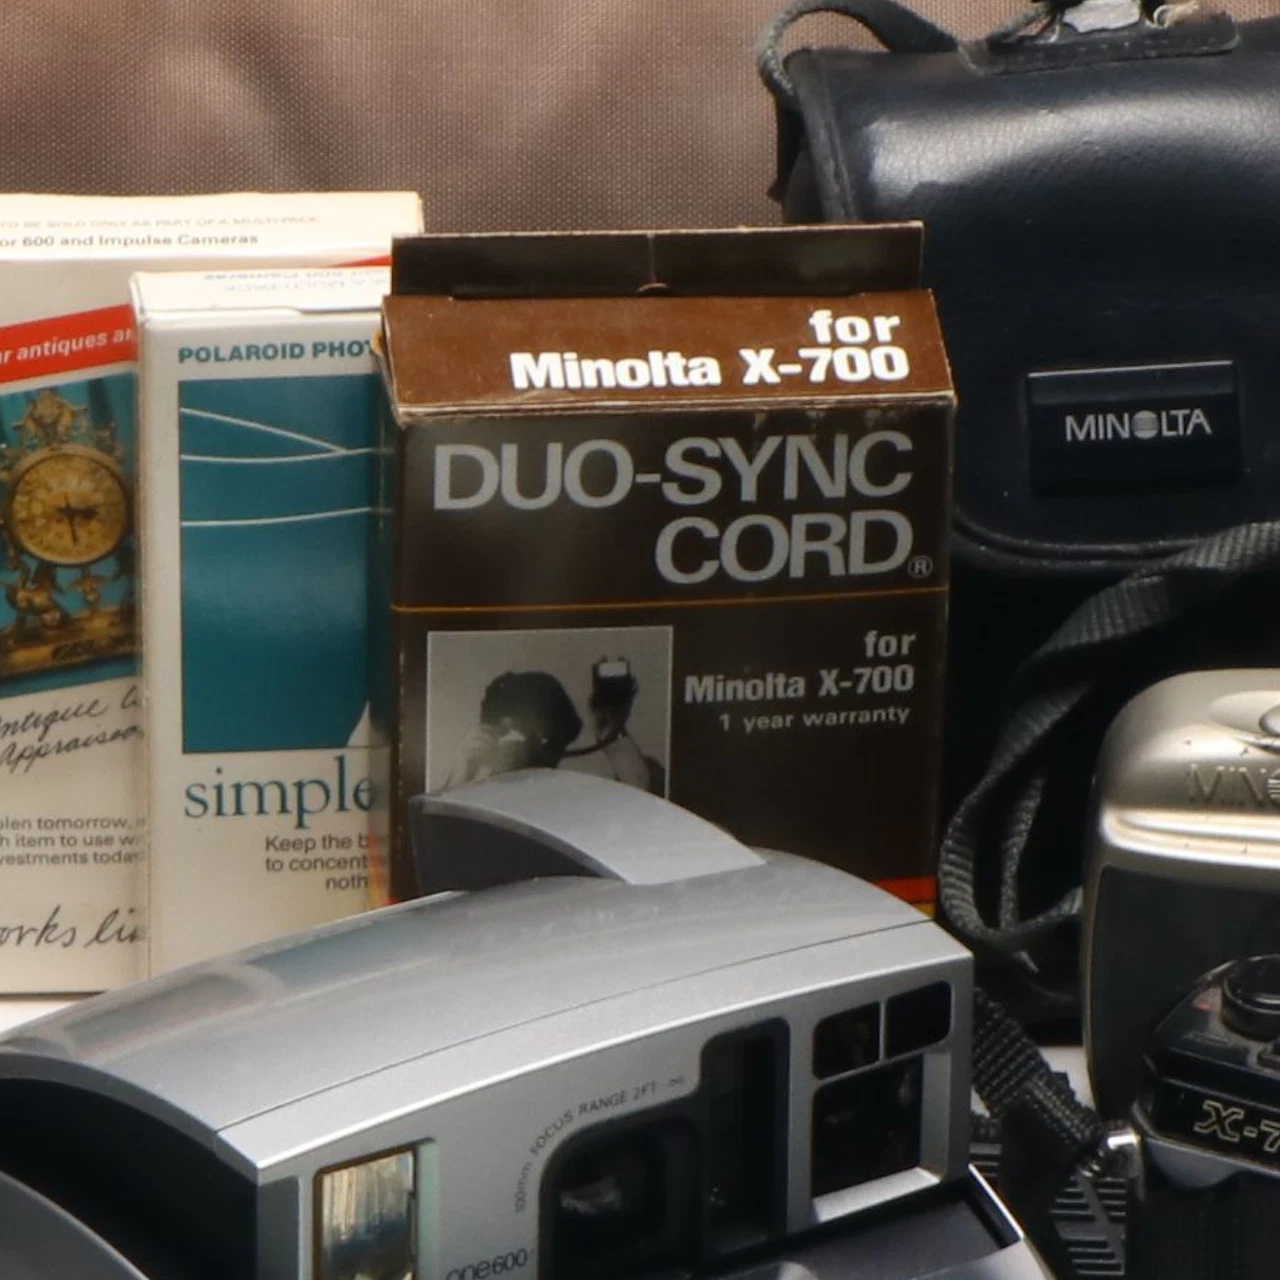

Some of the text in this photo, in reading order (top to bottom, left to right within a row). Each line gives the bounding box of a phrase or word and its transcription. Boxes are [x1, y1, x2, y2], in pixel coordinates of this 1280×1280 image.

[21, 236, 55, 248] 600
[59, 235, 95, 247] and
[98, 234, 173, 249] Impulse
[177, 233, 259, 247] Cameras
[809, 309, 901, 346] for
[16, 329, 108, 361] antiques
[113, 327, 133, 344] ar
[177, 339, 306, 364] POLAROID
[510, 346, 910, 390] Minolta X-700
[1065, 407, 1213, 443] MINOLTA
[433, 431, 914, 511] DUO-SYNC
[863, 630, 917, 658] for
[684, 667, 915, 704] Minolta X-700
[719, 704, 910, 733] 1 year warranty
[36, 816, 132, 832] tomorrow,
[15, 834, 115, 848] item to use
[265, 833, 353, 854] Keep the
[265, 854, 369, 872] to concent
[325, 873, 369, 891] noth
[530, 1108, 574, 1158] FOCUS
[577, 1090, 629, 1117] RANGE
